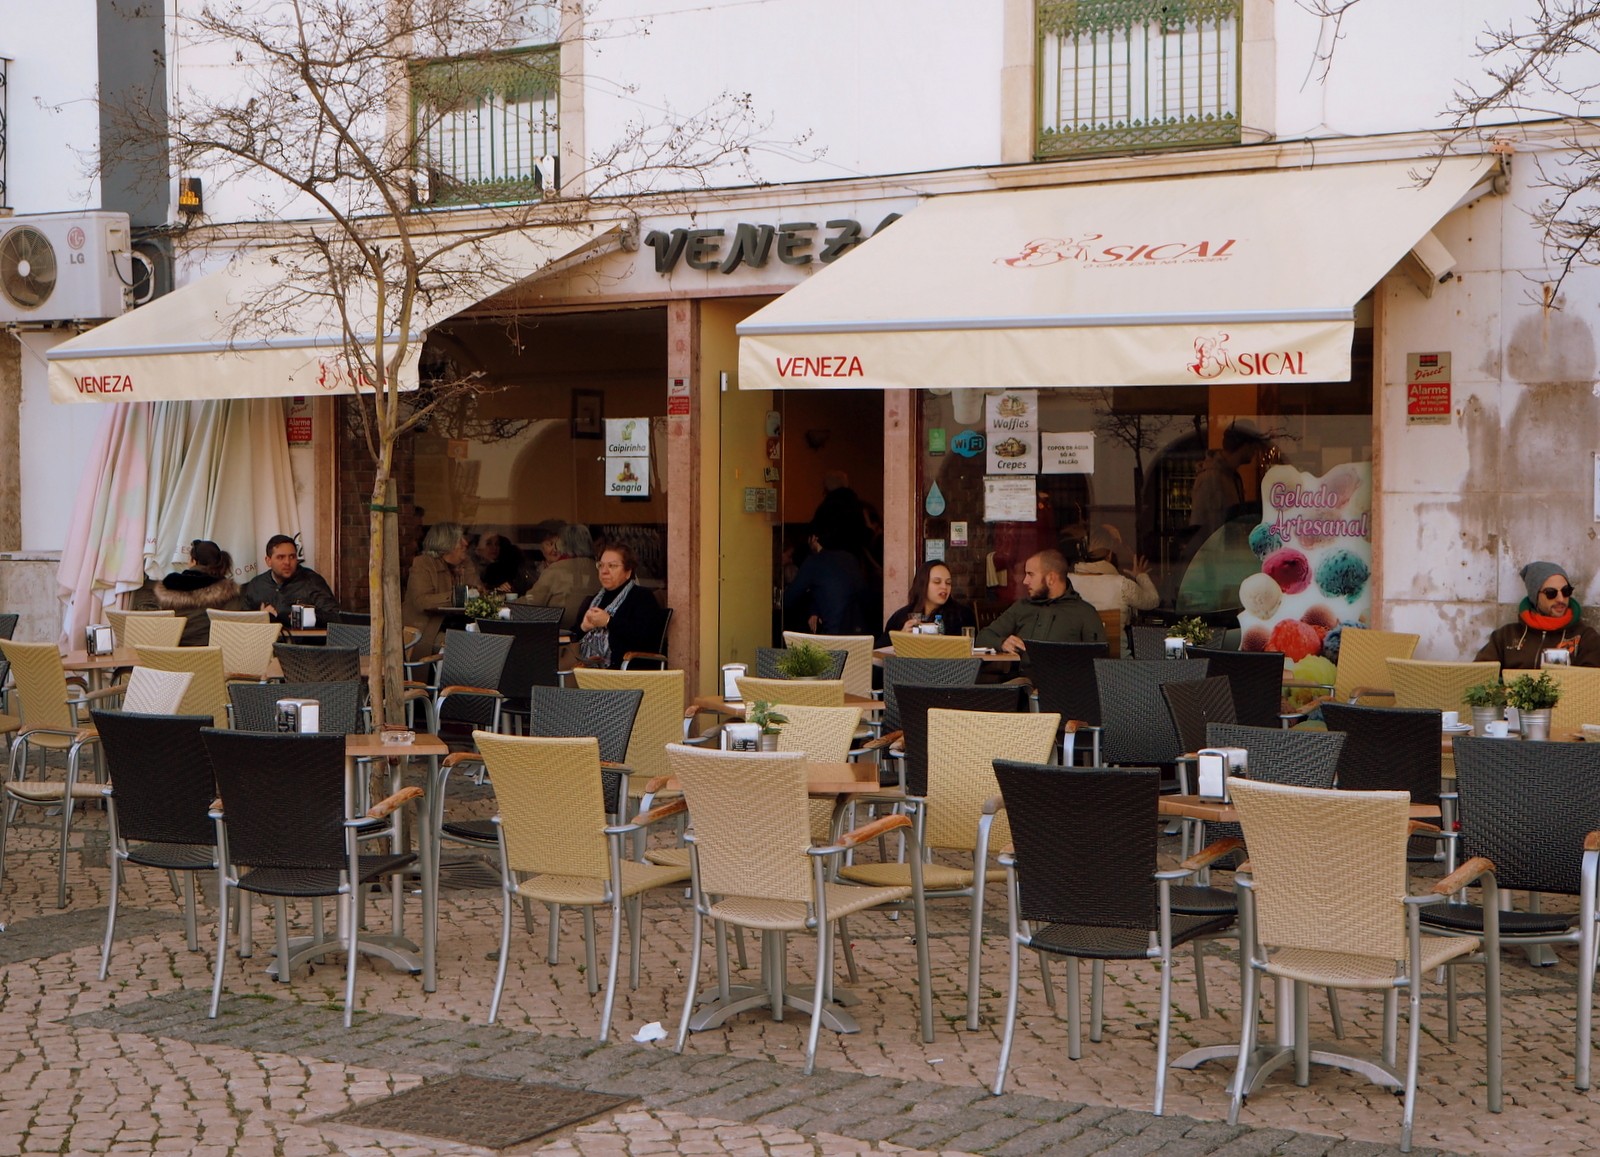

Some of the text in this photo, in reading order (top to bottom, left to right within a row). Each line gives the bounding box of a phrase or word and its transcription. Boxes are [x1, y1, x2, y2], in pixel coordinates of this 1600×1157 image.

[643, 212, 903, 275] VENEZ
[1092, 239, 1237, 262] SICAL
[70, 252, 85, 265] LG
[776, 356, 864, 378] VENEZA
[1238, 351, 1308, 376] SICAL
[74, 375, 133, 393] VENEZA
[1410, 385, 1448, 395] Alarme
[993, 419, 1029, 430] Waffles
[609, 444, 647, 454] Caipirinha
[997, 460, 1027, 470] Crepes
[611, 482, 642, 493] Sangria
[1270, 482, 1338, 509] Gelado
[1269, 510, 1369, 542] Artesanal
